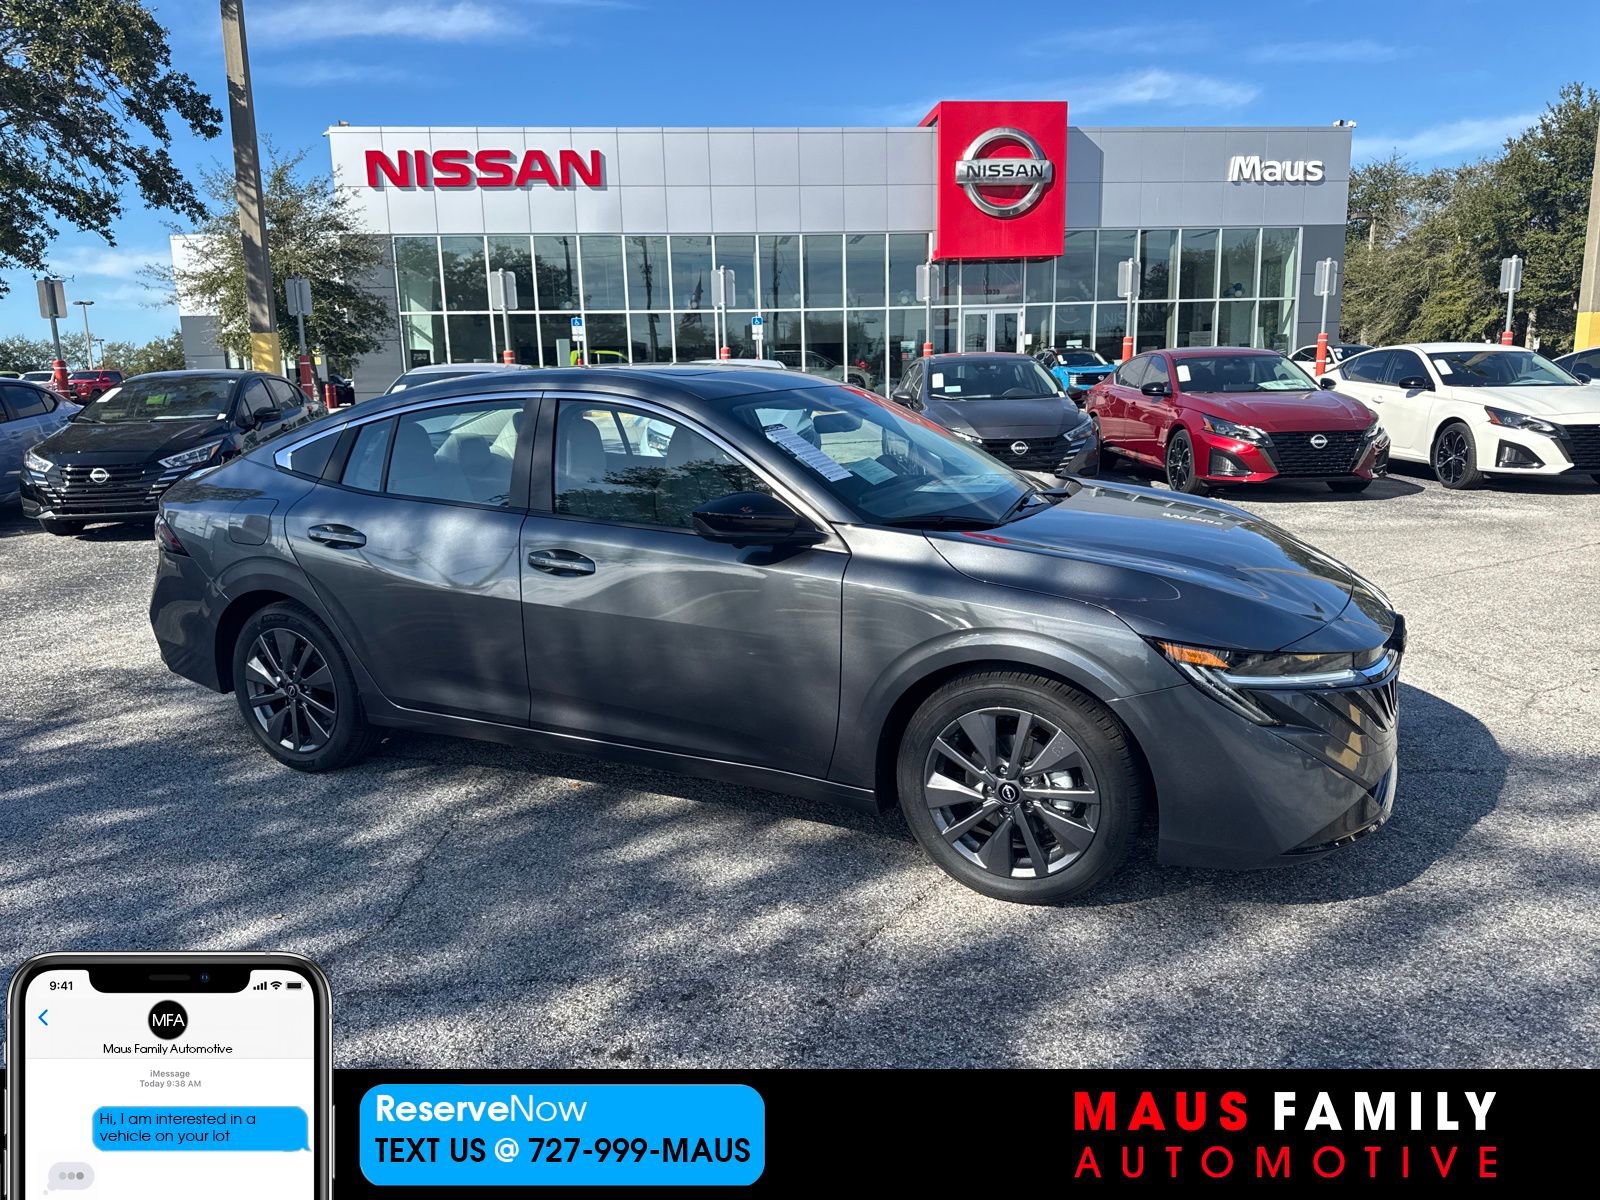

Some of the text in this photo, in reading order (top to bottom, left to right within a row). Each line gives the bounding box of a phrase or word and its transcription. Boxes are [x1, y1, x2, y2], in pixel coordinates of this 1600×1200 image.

[365, 150, 602, 188] NISSAN
[966, 164, 1044, 178] NISSAN
[1228, 155, 1324, 183] Maus
[1103, 311, 1154, 324] NISAN
